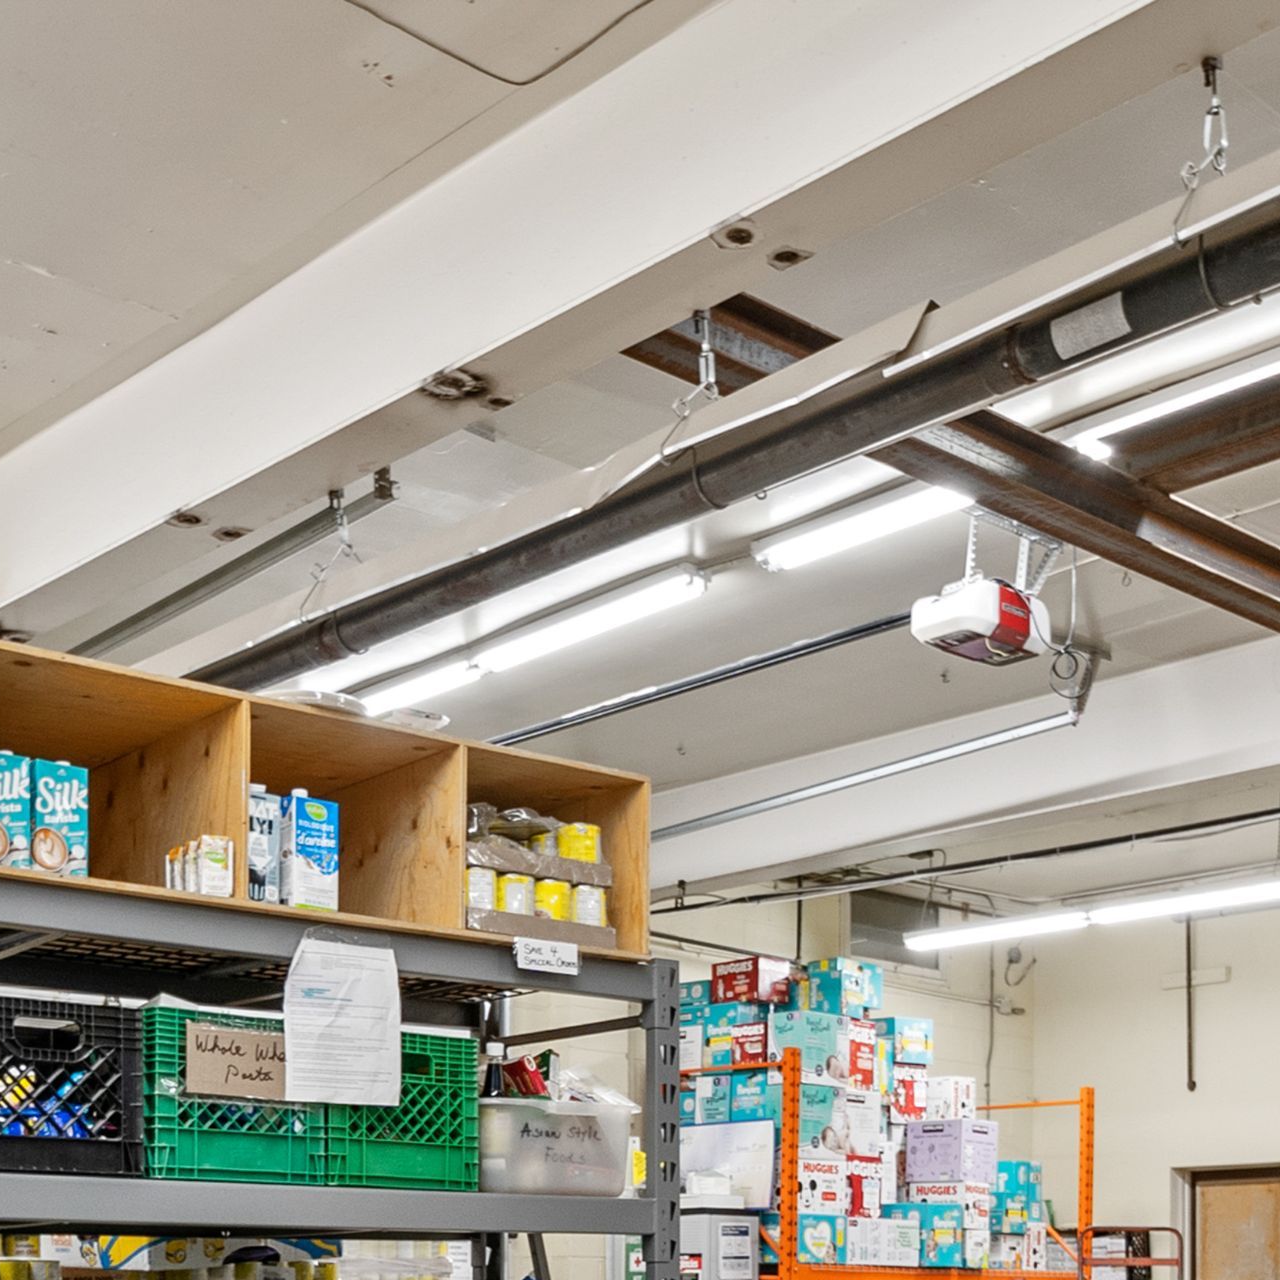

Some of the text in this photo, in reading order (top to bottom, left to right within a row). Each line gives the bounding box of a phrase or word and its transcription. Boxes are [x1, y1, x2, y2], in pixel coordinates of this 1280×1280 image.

[35, 777, 88, 813] Silk
[195, 1034, 247, 1057] Whole
[520, 1122, 602, 1141] Asian Style
[803, 1162, 839, 1175] HUGGIES
[916, 1185, 957, 1196] HUGGIES
